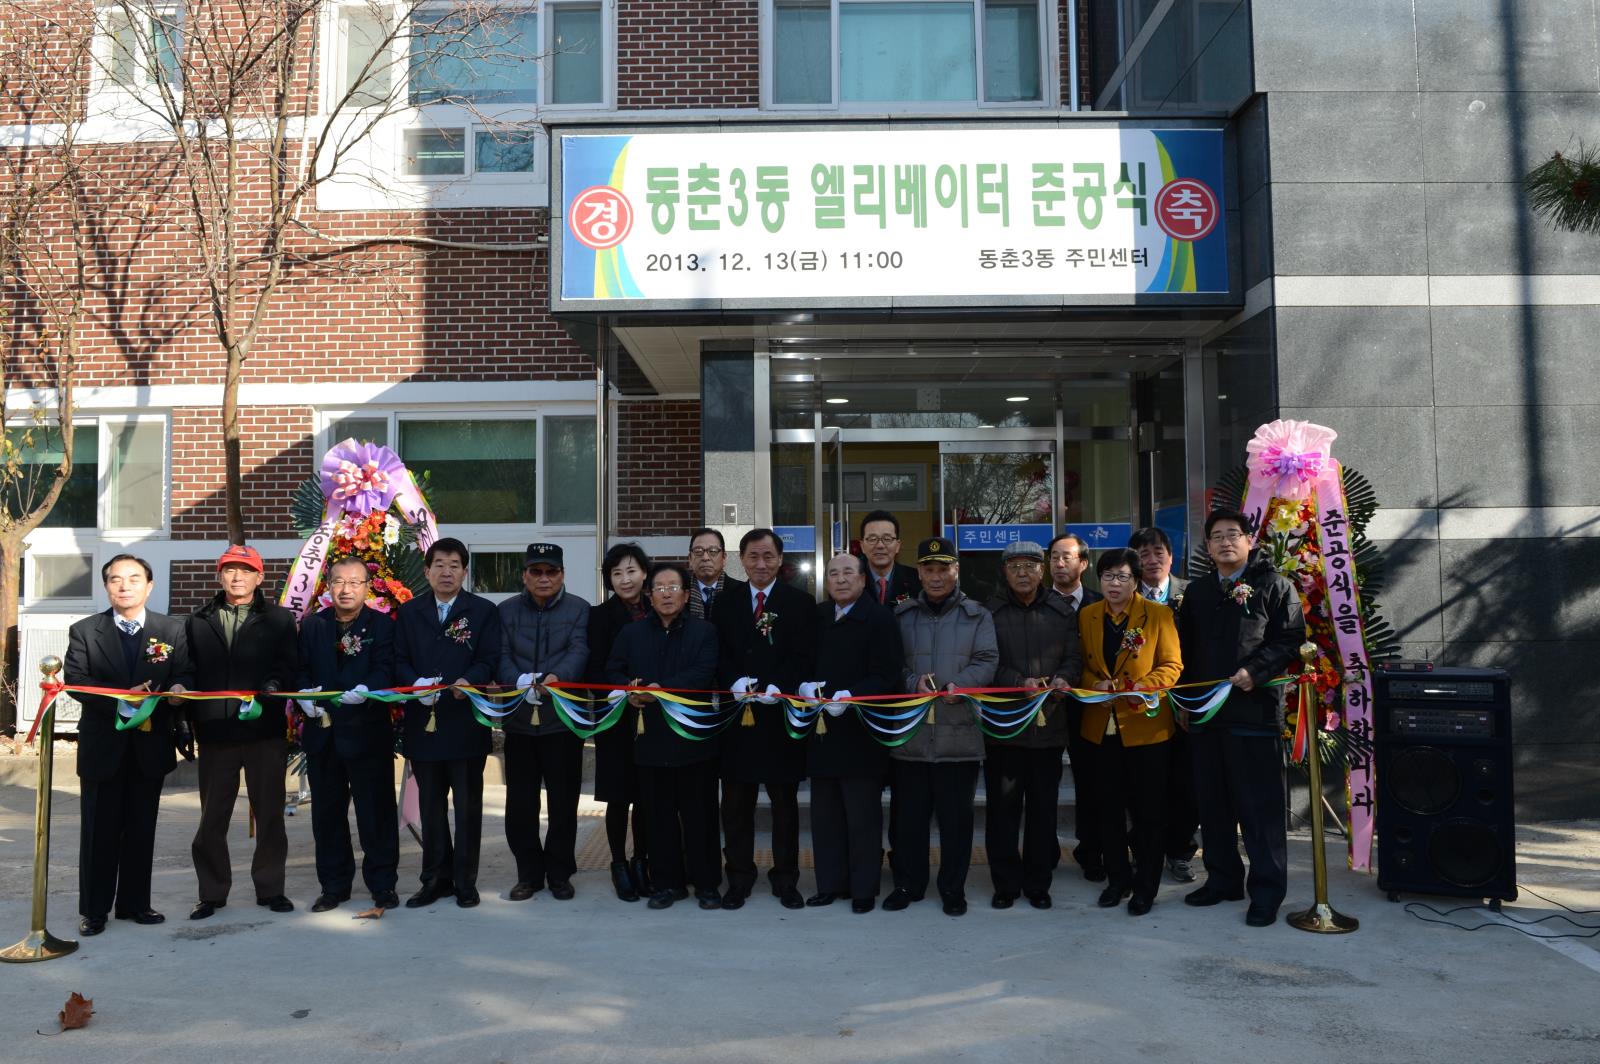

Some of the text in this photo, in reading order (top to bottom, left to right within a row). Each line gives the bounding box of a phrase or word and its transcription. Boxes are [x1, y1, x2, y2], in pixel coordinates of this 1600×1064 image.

[646, 161, 1149, 235] 동춘3동 엘리베이터 준공식
[1165, 189, 1208, 230] 축
[583, 201, 619, 240] 경
[646, 250, 903, 272] 2013. 12. 13(금) 11:00
[978, 247, 1149, 269] 동춘3동 주민센터
[963, 529, 1021, 545] 주민센터
[1320, 509, 1360, 634] 준공식을
